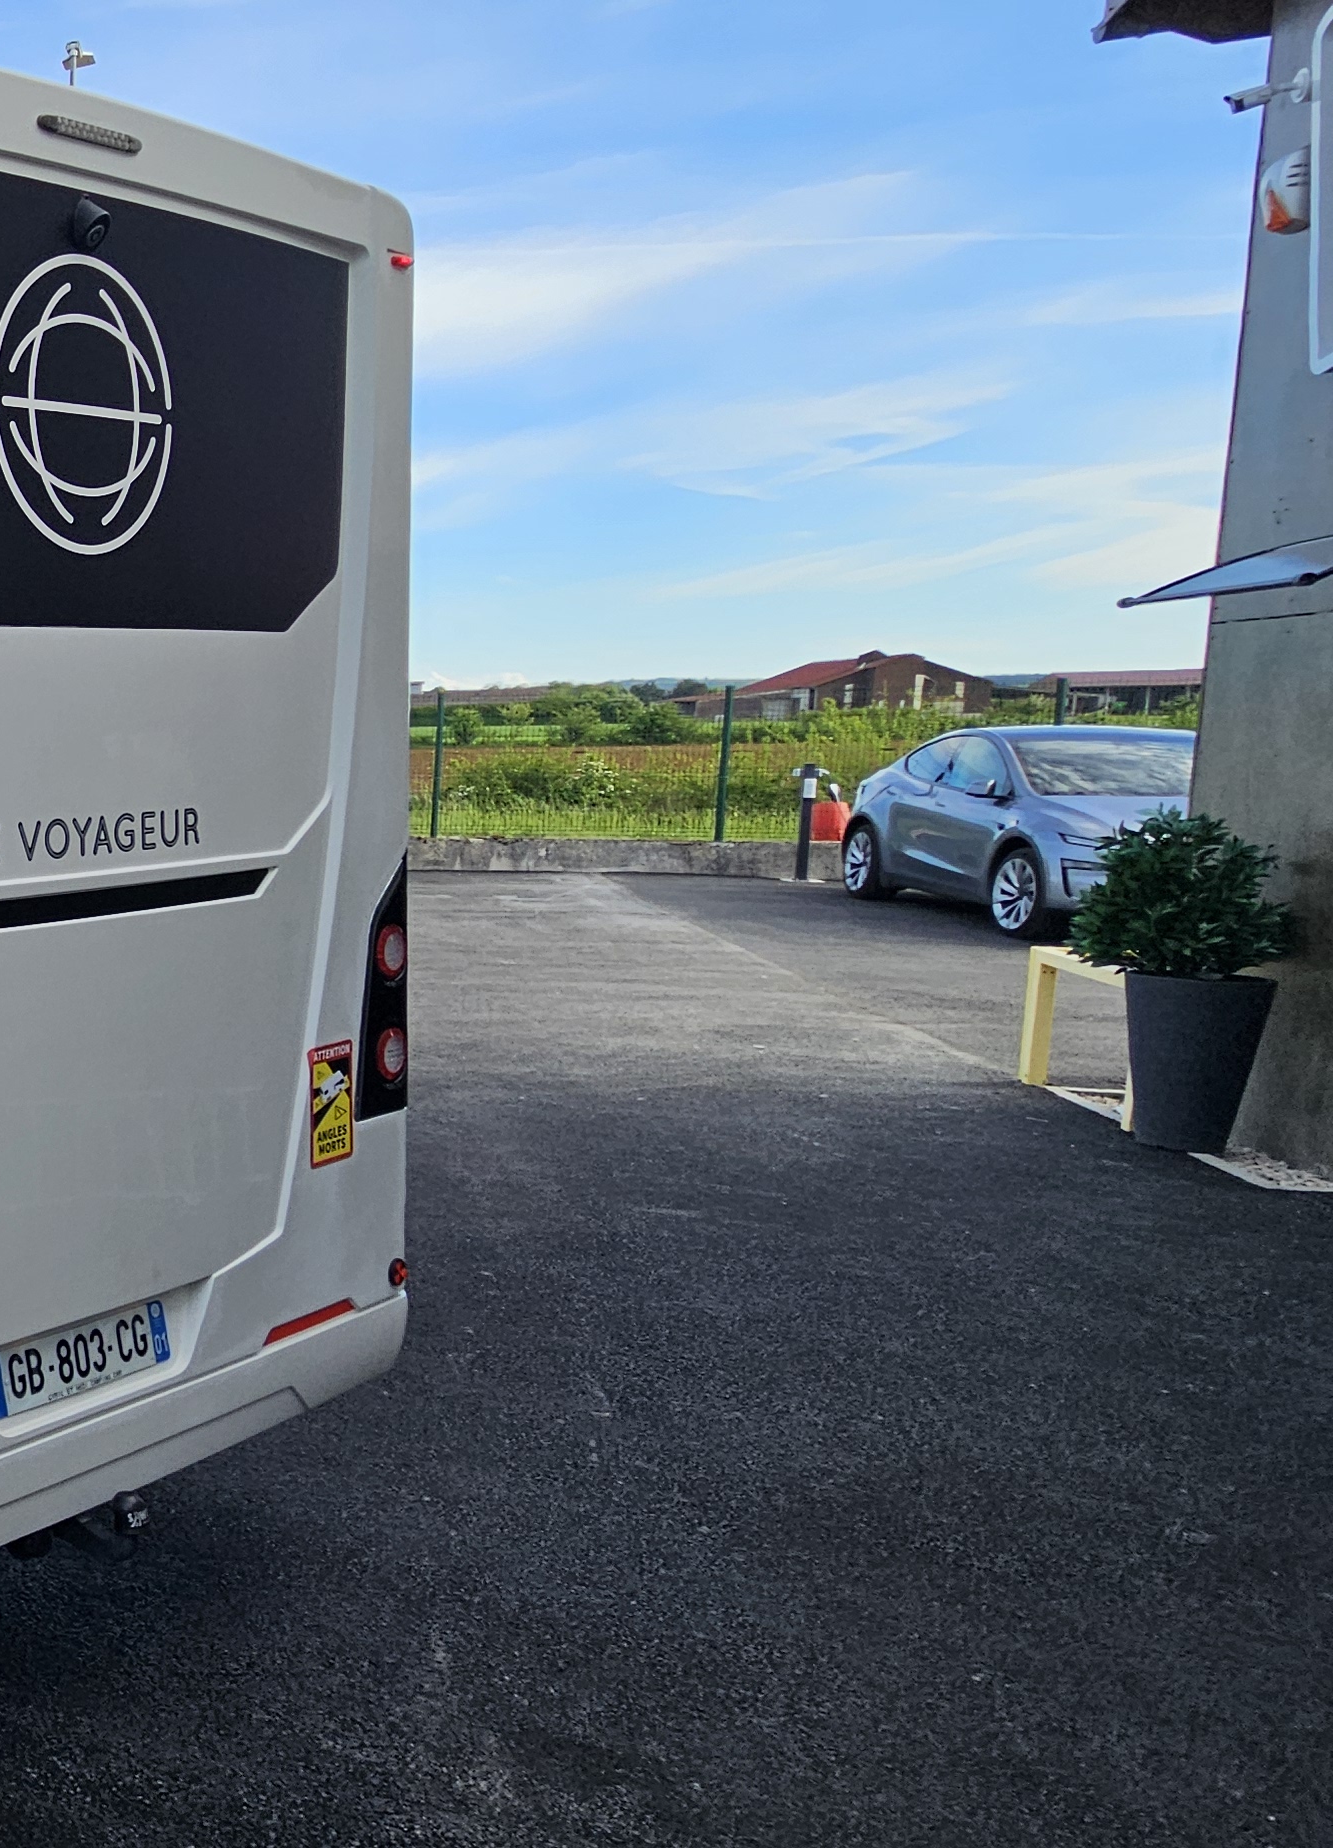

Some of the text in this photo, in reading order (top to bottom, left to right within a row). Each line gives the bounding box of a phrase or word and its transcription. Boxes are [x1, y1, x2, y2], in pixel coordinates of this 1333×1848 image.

[18, 808, 200, 862] VOYAGEUR
[314, 1044, 350, 1062] ATTENTION
[317, 1124, 347, 1143] ANGLES
[318, 1138, 346, 1156] MORTS
[154, 1332, 168, 1354] 01
